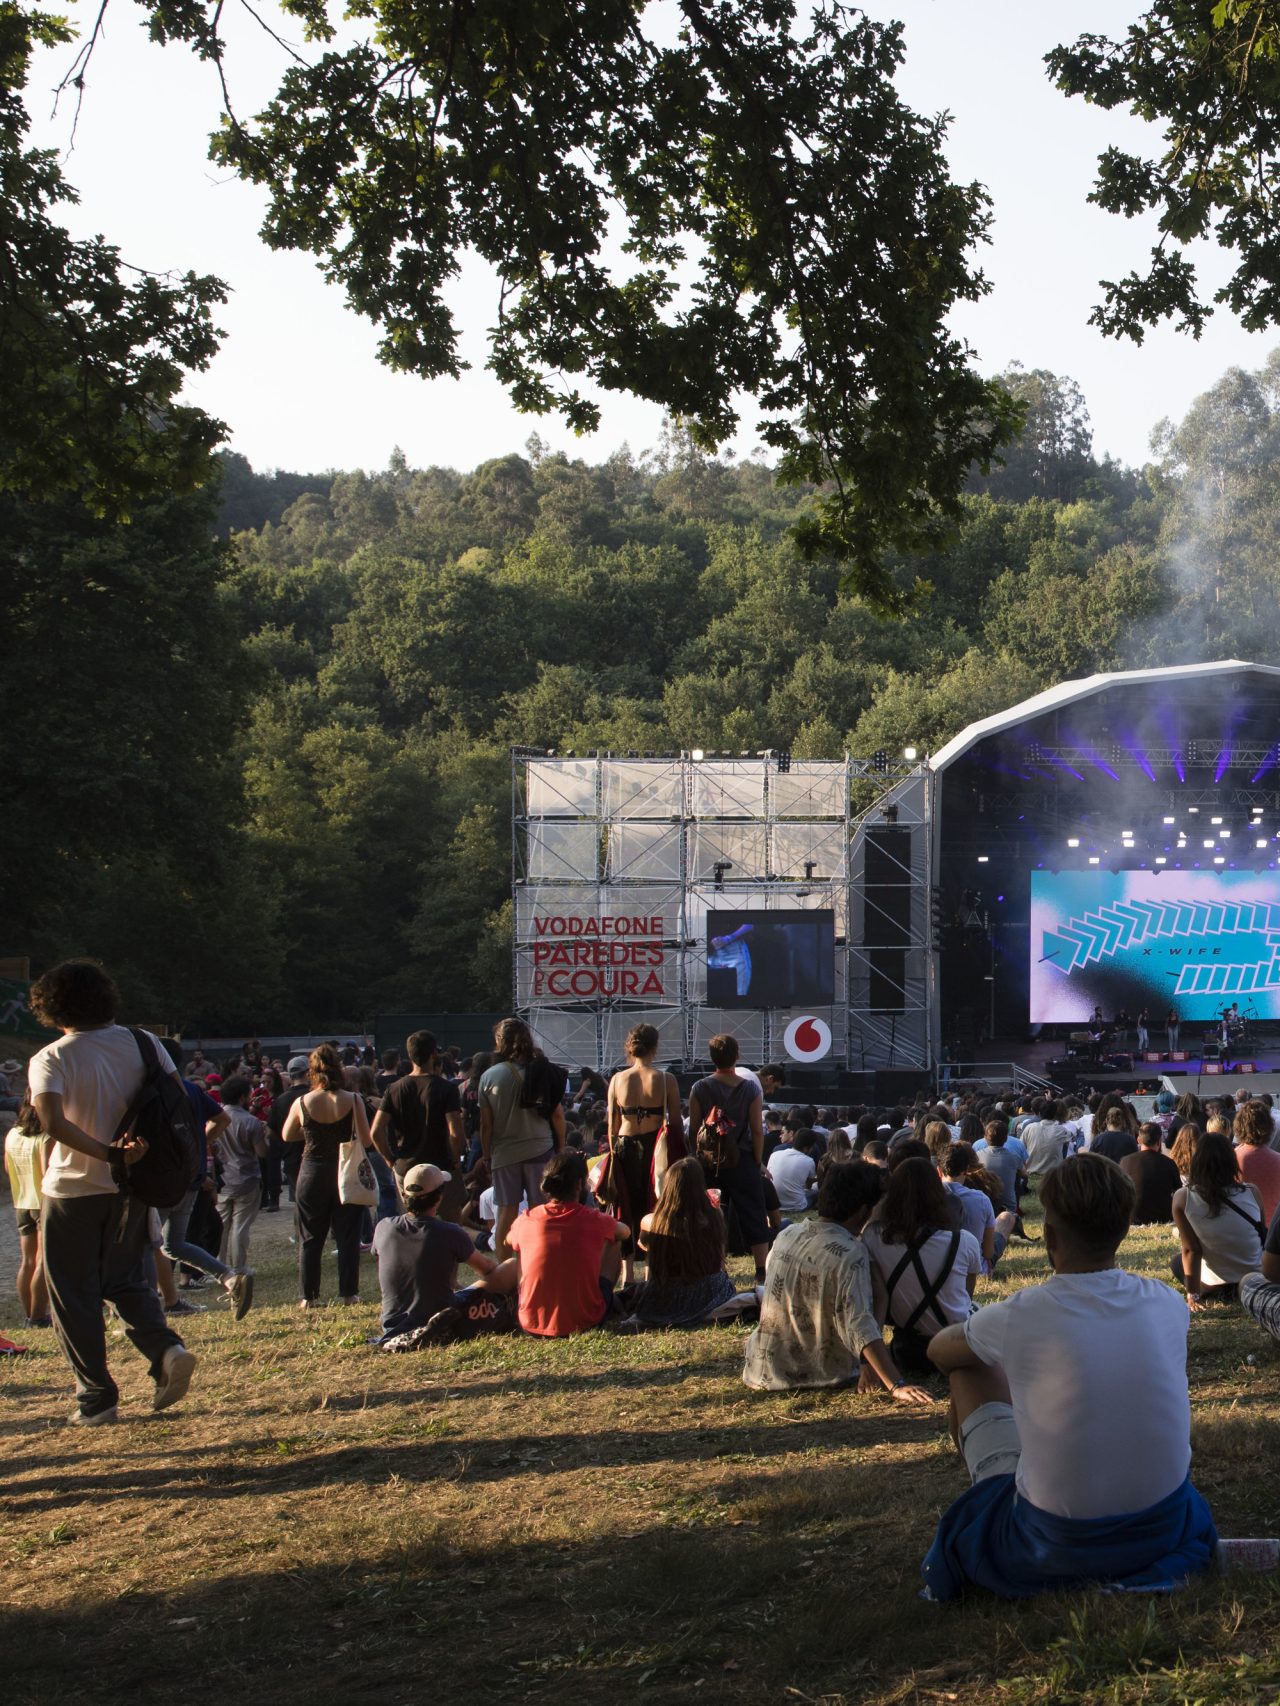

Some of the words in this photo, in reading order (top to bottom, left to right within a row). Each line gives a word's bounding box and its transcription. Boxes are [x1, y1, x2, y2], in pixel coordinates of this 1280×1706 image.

[534, 916, 664, 936] VODAFONE
[534, 941, 664, 966] PAREDES
[1142, 947, 1222, 956] X-WIFE
[534, 971, 545, 996] DE
[547, 969, 665, 997] COURA
